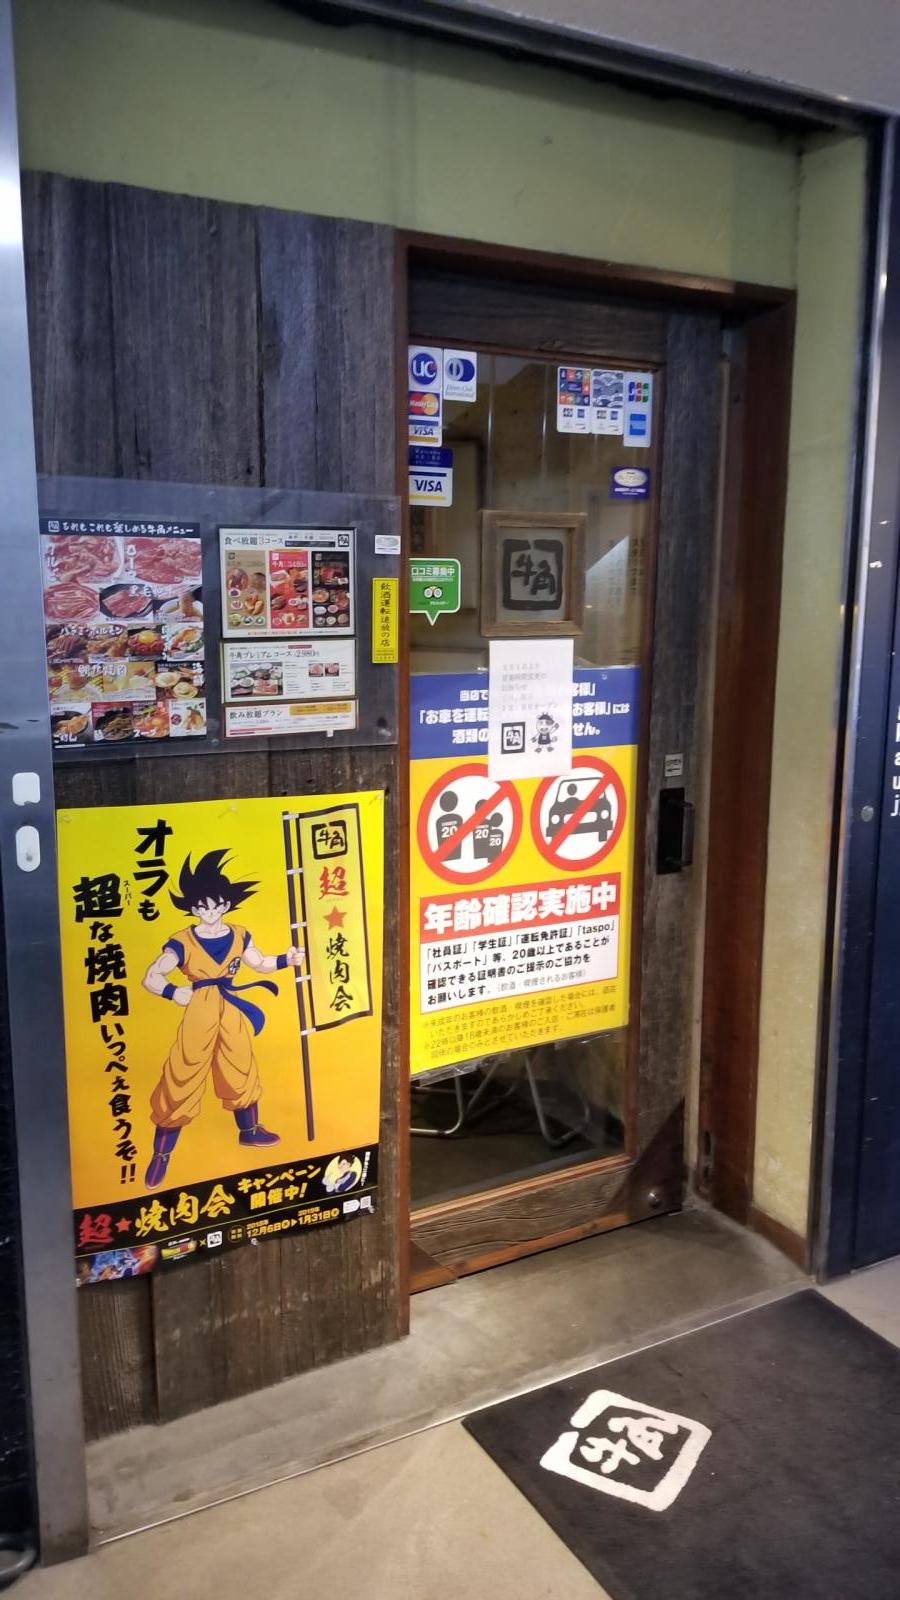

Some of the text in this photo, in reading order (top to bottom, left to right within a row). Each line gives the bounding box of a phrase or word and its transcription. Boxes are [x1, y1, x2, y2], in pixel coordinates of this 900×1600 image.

[412, 360, 436, 378] UC
[414, 427, 434, 436] VISA
[414, 479, 442, 493] VISA
[475, 828, 489, 840] 20
[489, 837, 502, 847] 20
[133, 819, 174, 922] オラも
[424, 881, 617, 934] 年齢確認実施中
[327, 932, 354, 1011] 焼肉会
[428, 954, 591, 990] 確認できる証明書のご提示のご協力を
[238, 1164, 321, 1194] キャンペーン
[250, 1182, 308, 1210] 開催中!
[135, 1184, 236, 1238] 焼肉会
